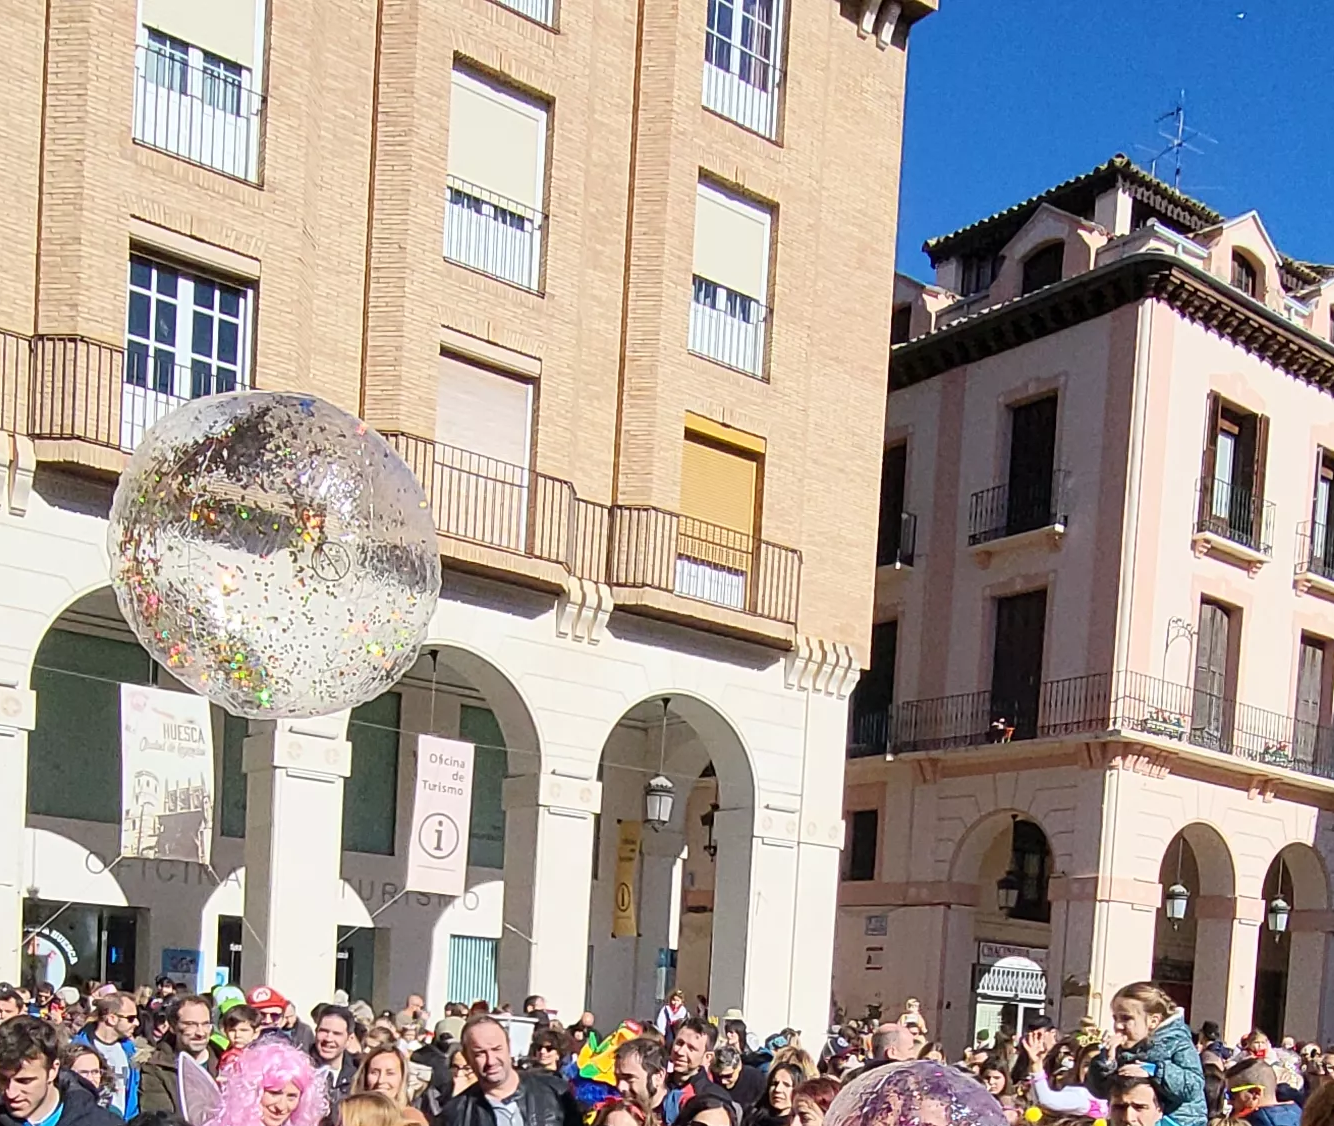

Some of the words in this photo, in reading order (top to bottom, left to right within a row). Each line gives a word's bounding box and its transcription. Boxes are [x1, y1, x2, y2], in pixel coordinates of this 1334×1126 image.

[162, 723, 206, 745] HUESCA
[429, 753, 465, 769] Oficina
[452, 771, 465, 783] de
[421, 779, 464, 796] Turismo
